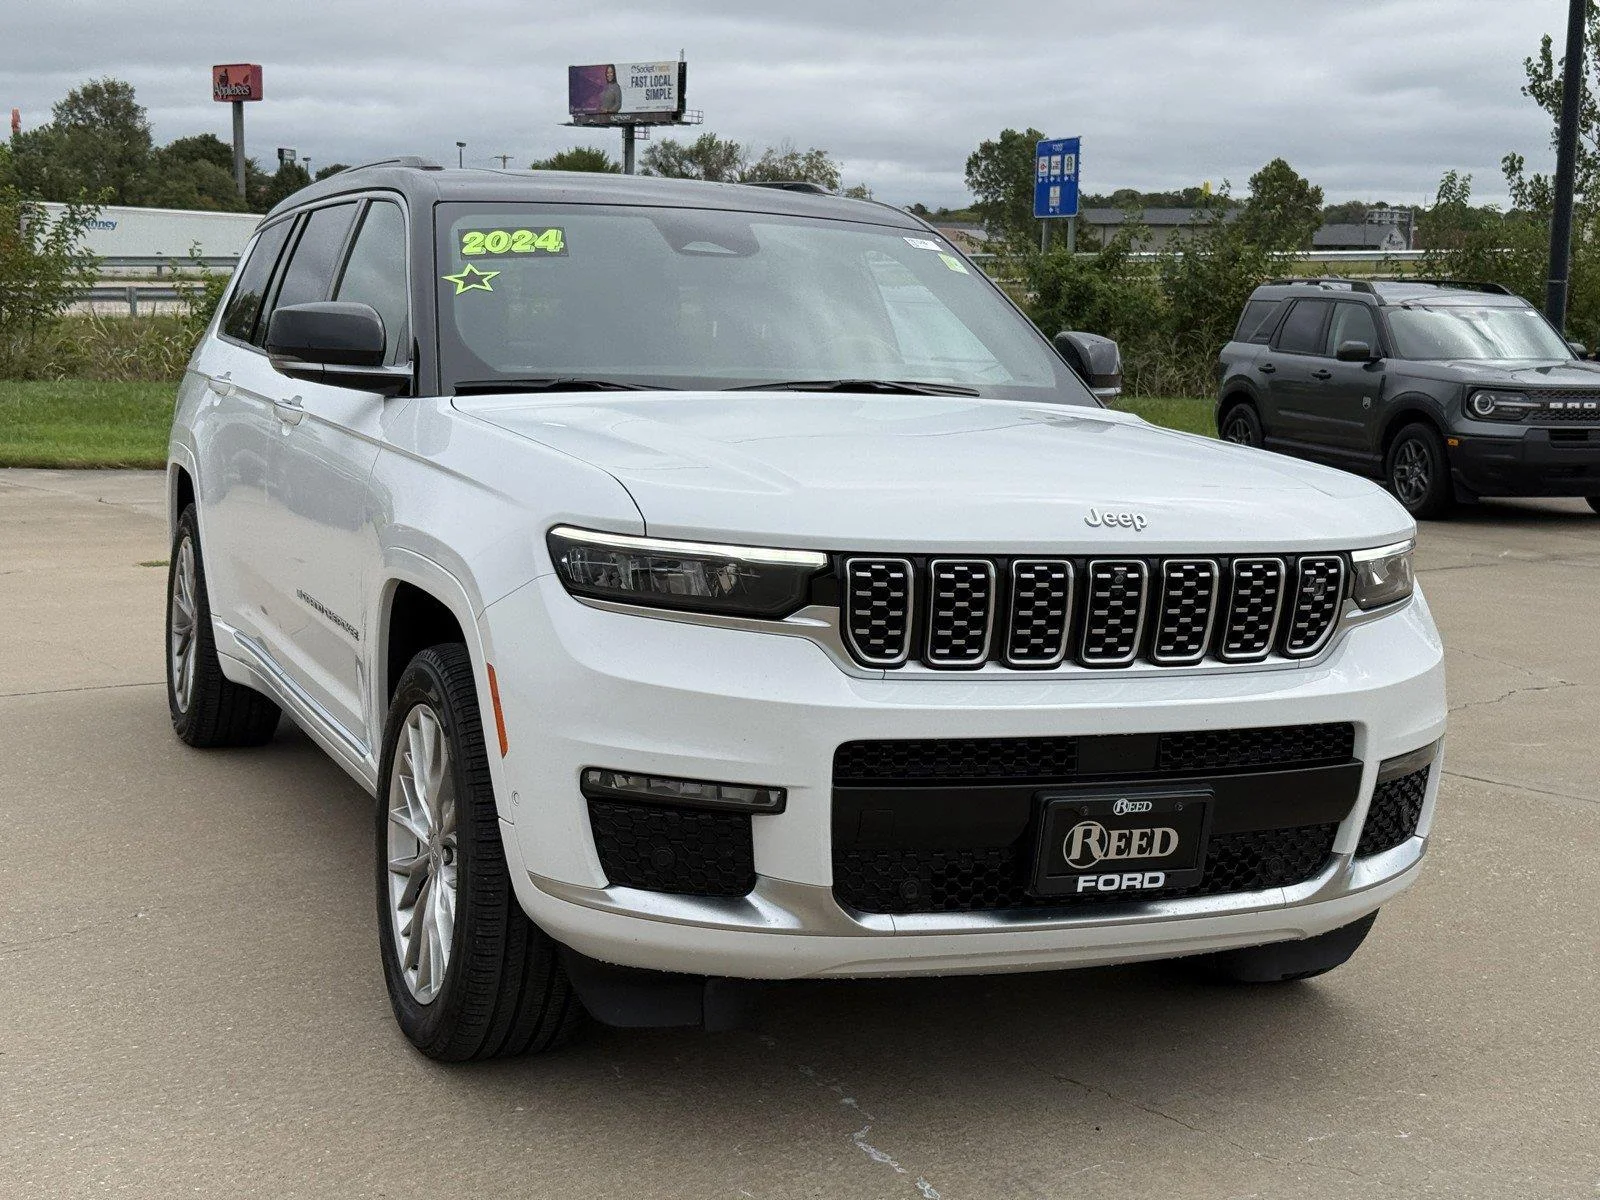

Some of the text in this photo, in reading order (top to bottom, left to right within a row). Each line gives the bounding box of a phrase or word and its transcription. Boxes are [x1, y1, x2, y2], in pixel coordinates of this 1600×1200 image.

[631, 74, 674, 88] FAST. LOCAL.
[645, 87, 674, 100] SIMPLE.
[462, 229, 564, 255] 2024
[1083, 506, 1147, 532] Jeep
[1112, 798, 1152, 816] REED
[1063, 821, 1179, 868] REED
[1076, 871, 1165, 893] FORD
